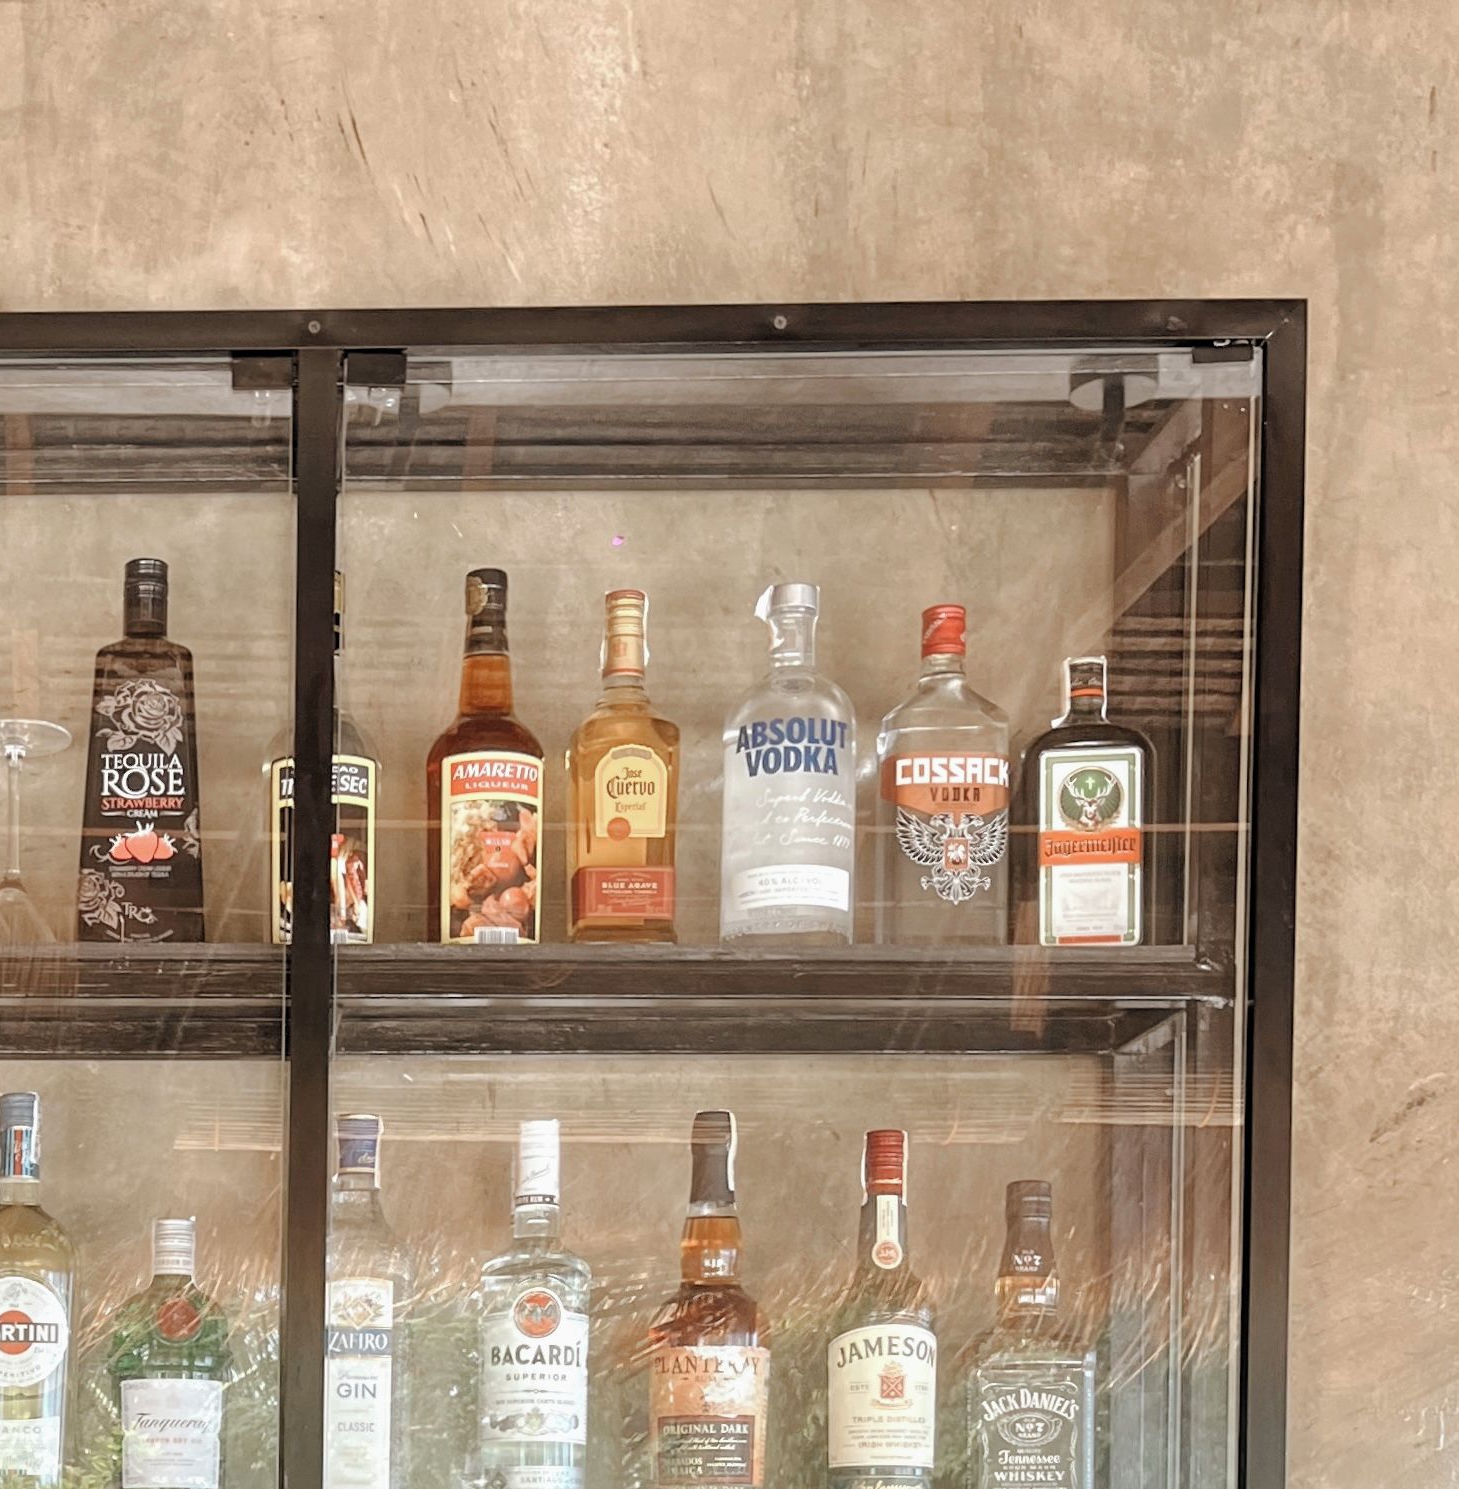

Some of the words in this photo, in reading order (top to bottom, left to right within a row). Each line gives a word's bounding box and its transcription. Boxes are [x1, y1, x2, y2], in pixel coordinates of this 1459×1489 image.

[736, 716, 847, 754] ABSOLUT
[101, 753, 183, 769] TEQUILA
[745, 745, 839, 777] VODKA
[452, 762, 538, 782] AMARETTO
[896, 757, 1010, 786] COSSACK
[101, 768, 186, 799] ROSE
[339, 774, 367, 794] SEC
[464, 780, 529, 791] LIQUEUR
[606, 776, 655, 799] Cuervo
[101, 796, 185, 810] STRAWBERRY
[929, 786, 981, 802] VODKA
[126, 808, 159, 819] CREAM
[328, 1331, 389, 1353] ZAFIRO
[491, 1341, 581, 1368] BACARDÍ
[837, 1335, 935, 1369] JAMESON
[505, 1373, 567, 1381] SUPERIOR
[336, 1383, 377, 1399] GIN
[981, 1393, 1019, 1422] JACK
[1020, 1388, 1079, 1420] DANIEL'S
[133, 1412, 213, 1434] Tanqueray
[337, 1421, 375, 1433] CLASSIC
[852, 1416, 884, 1424] TRIPLE
[663, 1424, 717, 1436] ORIGINAL
[720, 1424, 750, 1435] DARK
[998, 1450, 1061, 1464] Tennessee
[994, 1471, 1066, 1481] WHISKEY
